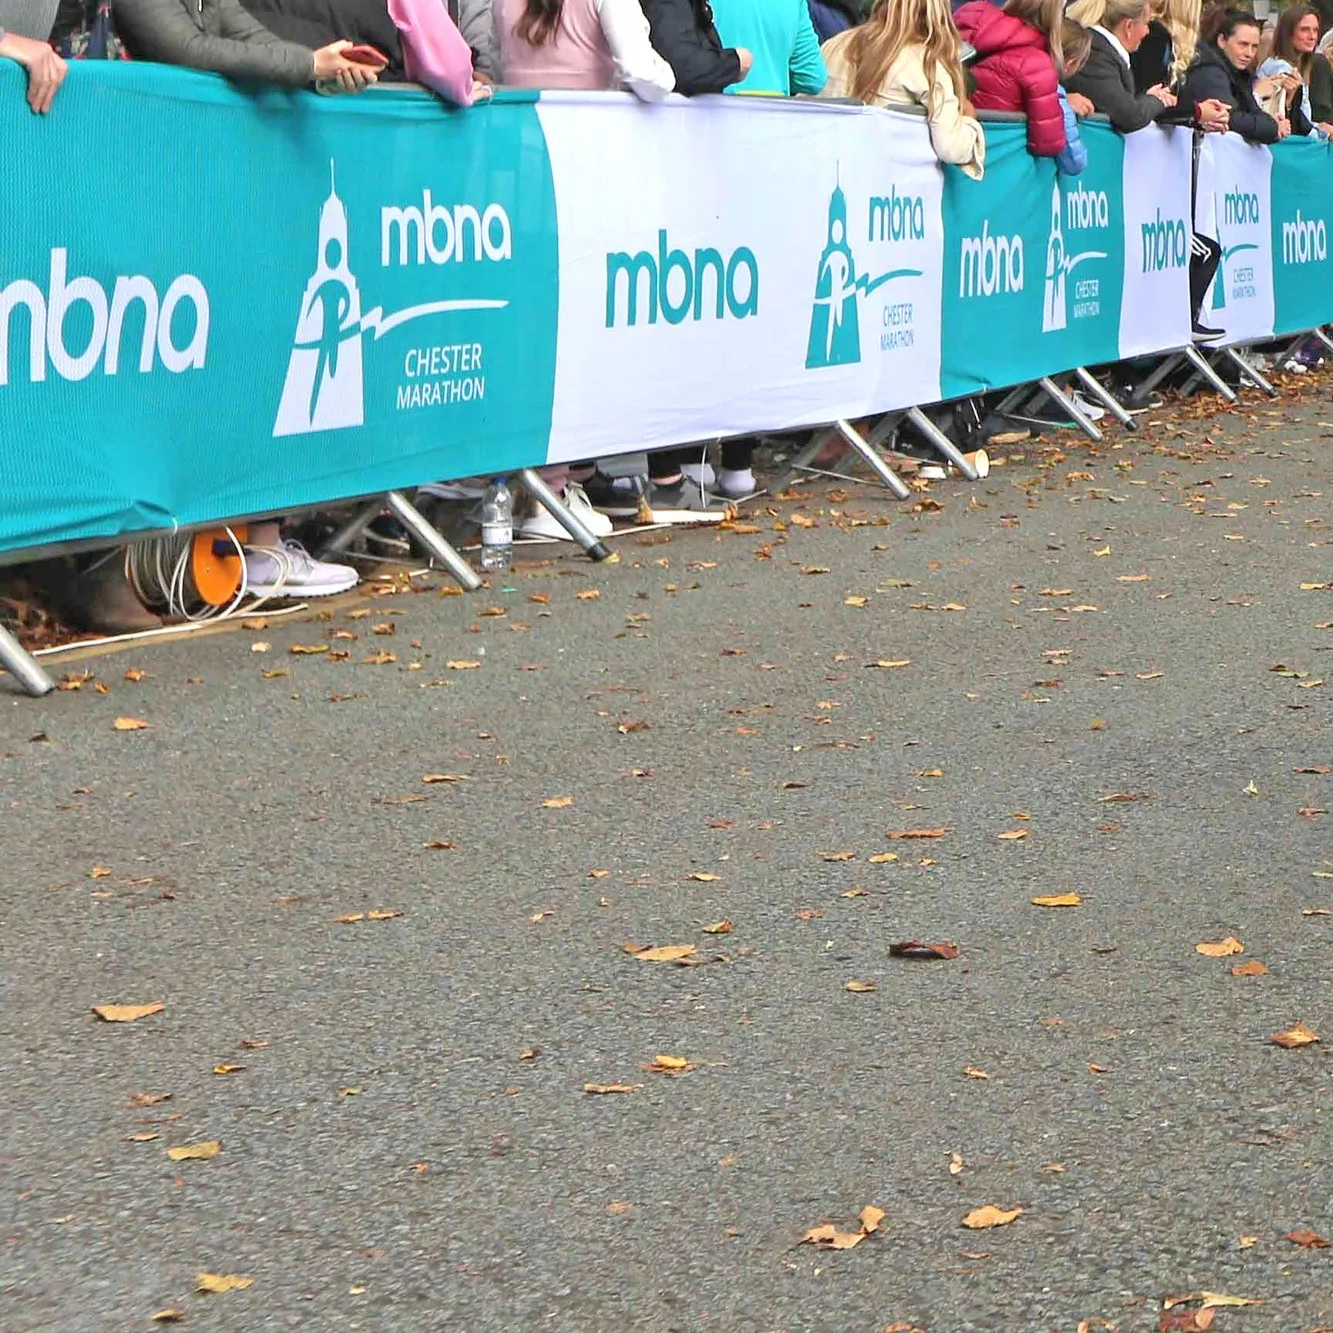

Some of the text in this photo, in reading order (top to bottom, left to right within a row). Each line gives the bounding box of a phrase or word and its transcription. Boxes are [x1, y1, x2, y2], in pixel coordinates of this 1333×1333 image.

[380, 189, 512, 267] mbna
[868, 184, 925, 242] mbna
[1067, 180, 1109, 230] mbna
[1225, 184, 1259, 225] mbna
[959, 219, 1024, 298] mbna
[1141, 207, 1186, 273] mbna
[1282, 209, 1327, 265] mbna
[605, 228, 758, 329] mbna
[880, 328, 914, 352] MARATHON
[882, 303, 913, 327] CHESTER
[404, 343, 483, 376] CHESTER
[396, 376, 486, 410] MARATHON
